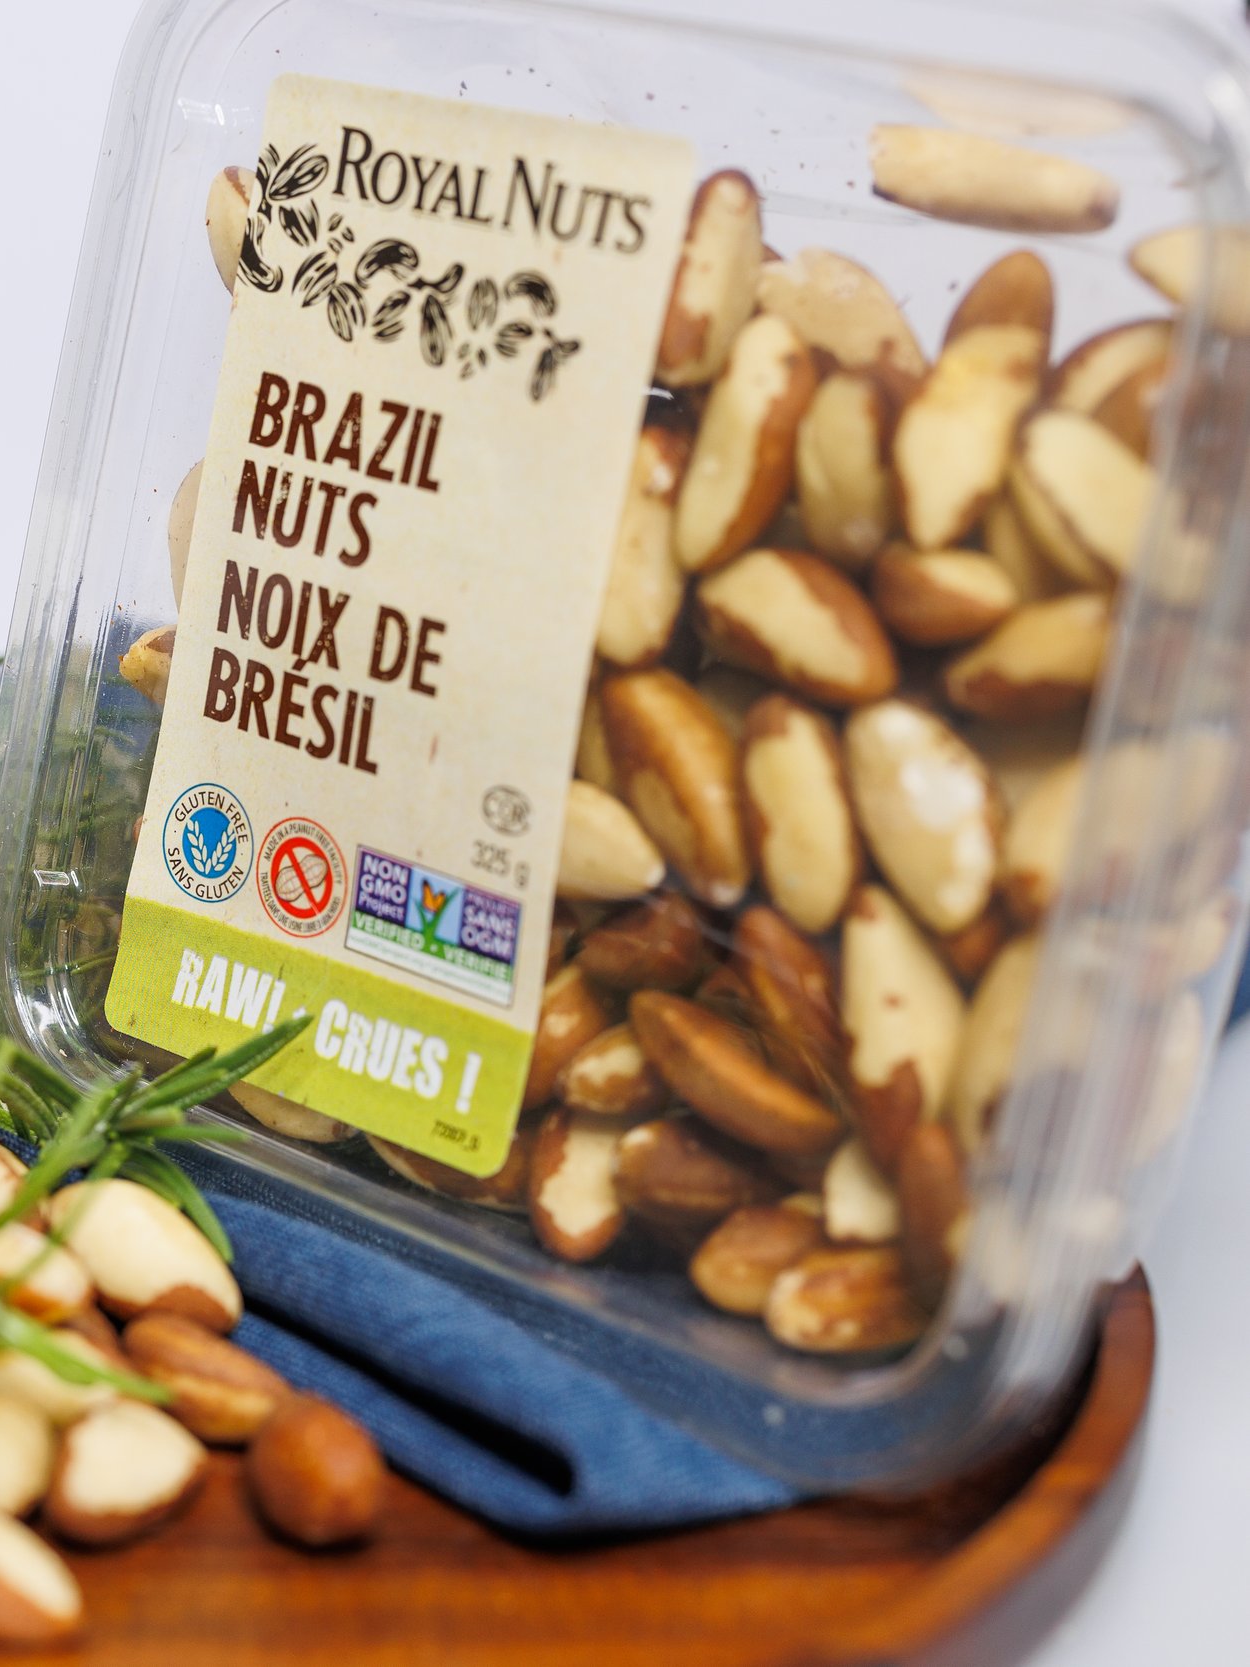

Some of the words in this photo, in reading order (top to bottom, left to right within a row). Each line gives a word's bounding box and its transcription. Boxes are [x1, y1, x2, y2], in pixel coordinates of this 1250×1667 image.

[332, 125, 494, 225] ROYAL
[503, 154, 653, 255] NUTS
[248, 371, 442, 494] BRAZIL
[231, 458, 379, 568] NUTS
[216, 559, 352, 672] NOIX
[367, 604, 447, 698] DE
[203, 646, 379, 775] BRÉSIL
[174, 791, 226, 822] GLUTEN
[225, 802, 249, 844] FREE
[167, 847, 195, 890] SANS
[195, 865, 244, 899] GLUTEN
[264, 836, 276, 862] MADE
[362, 854, 409, 886] NON
[469, 839, 512, 878] 325
[358, 890, 405, 920] Project
[360, 872, 408, 905] GMO
[355, 911, 425, 951] VERIFIED
[461, 925, 512, 957] OGM
[464, 904, 515, 937] SANS
[171, 948, 286, 1034] RAW!
[313, 998, 449, 1100] CRUES
[455, 1051, 482, 1115] !
